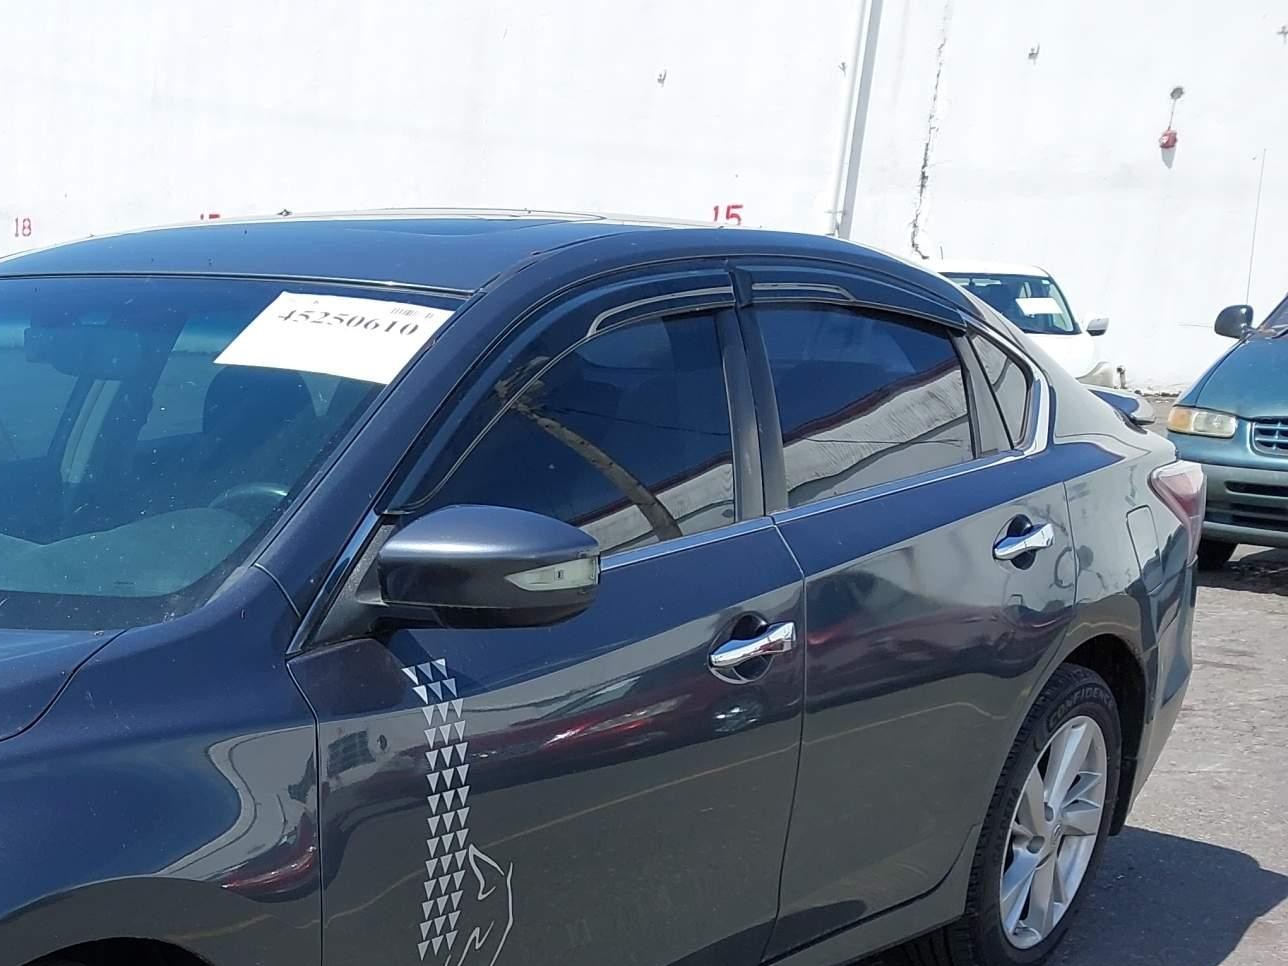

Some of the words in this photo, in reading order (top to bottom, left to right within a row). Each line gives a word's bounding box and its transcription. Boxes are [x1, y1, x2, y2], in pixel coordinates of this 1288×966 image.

[713, 205, 743, 226] 15
[14, 217, 32, 238] 18
[278, 309, 419, 336] 45250610
